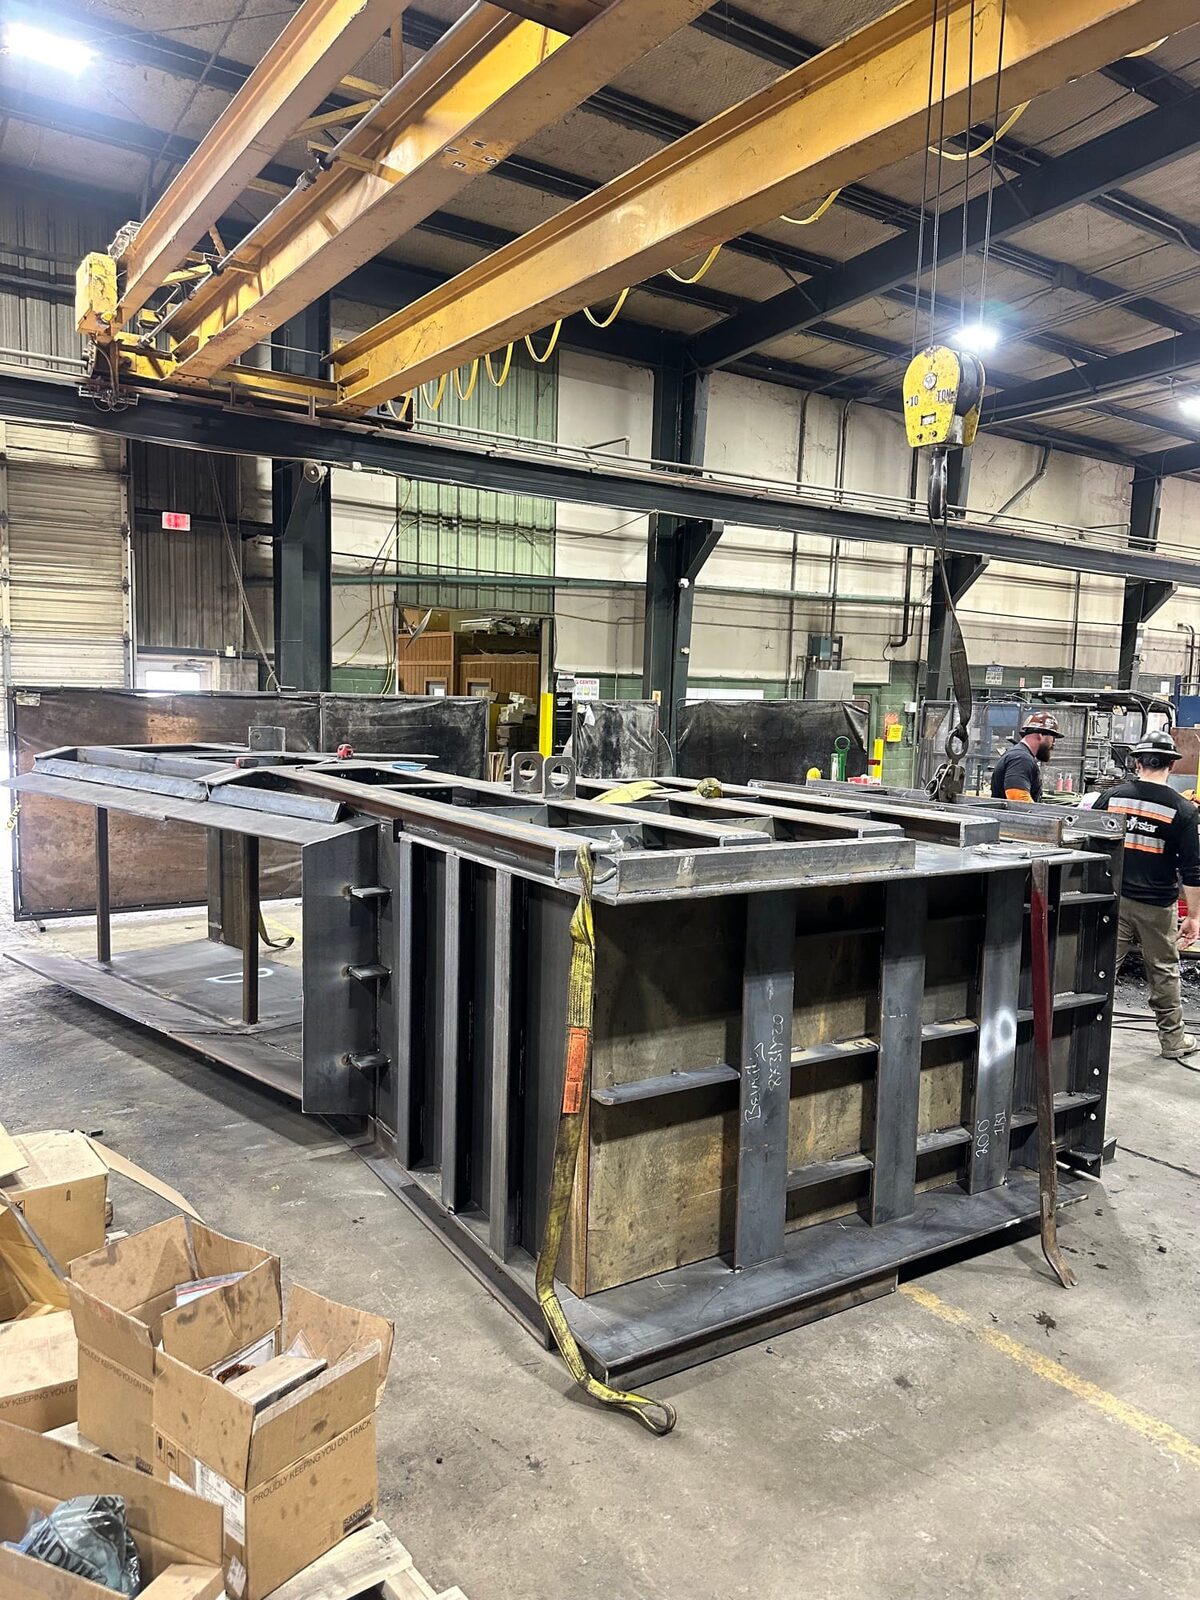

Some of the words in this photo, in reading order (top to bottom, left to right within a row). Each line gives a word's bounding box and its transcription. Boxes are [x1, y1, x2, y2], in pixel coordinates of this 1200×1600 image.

[910, 395, 919, 407] 10
[12, 1391, 49, 1407] KEEPING
[50, 1386, 68, 1398] YOU
[252, 1473, 289, 1504] PROUDLY
[289, 1453, 321, 1480] KEEPING
[321, 1440, 337, 1458] YOU
[337, 1434, 349, 1447] ON
[349, 1418, 372, 1440] TRACK
